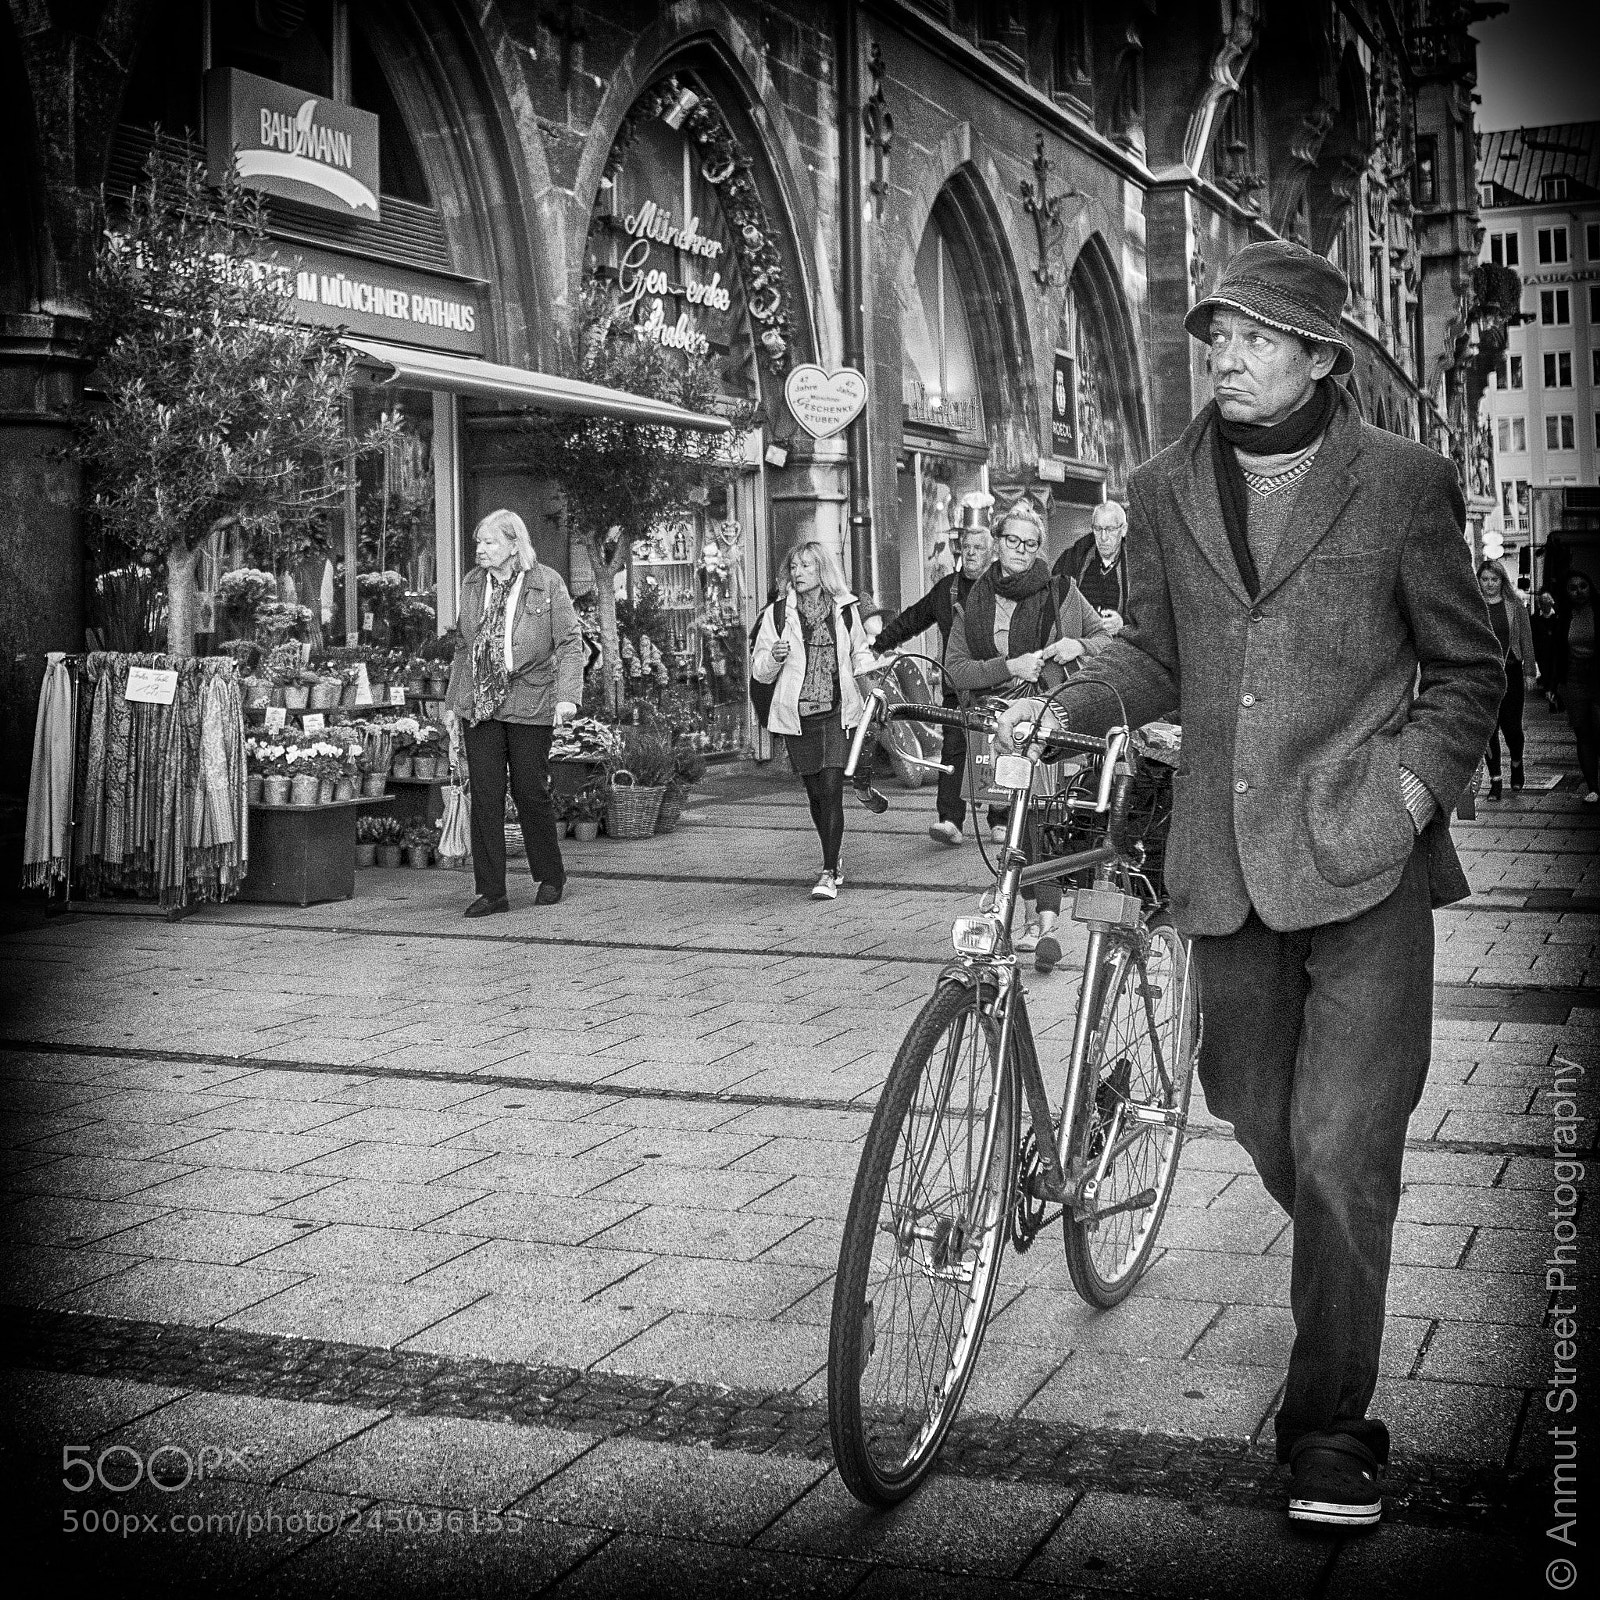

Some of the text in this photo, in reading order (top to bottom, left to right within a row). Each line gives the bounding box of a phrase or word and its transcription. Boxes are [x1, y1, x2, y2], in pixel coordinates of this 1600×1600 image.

[297, 272, 475, 332] IM MÜNCHNER RATHAUS
[804, 413, 841, 424] STUBEN
